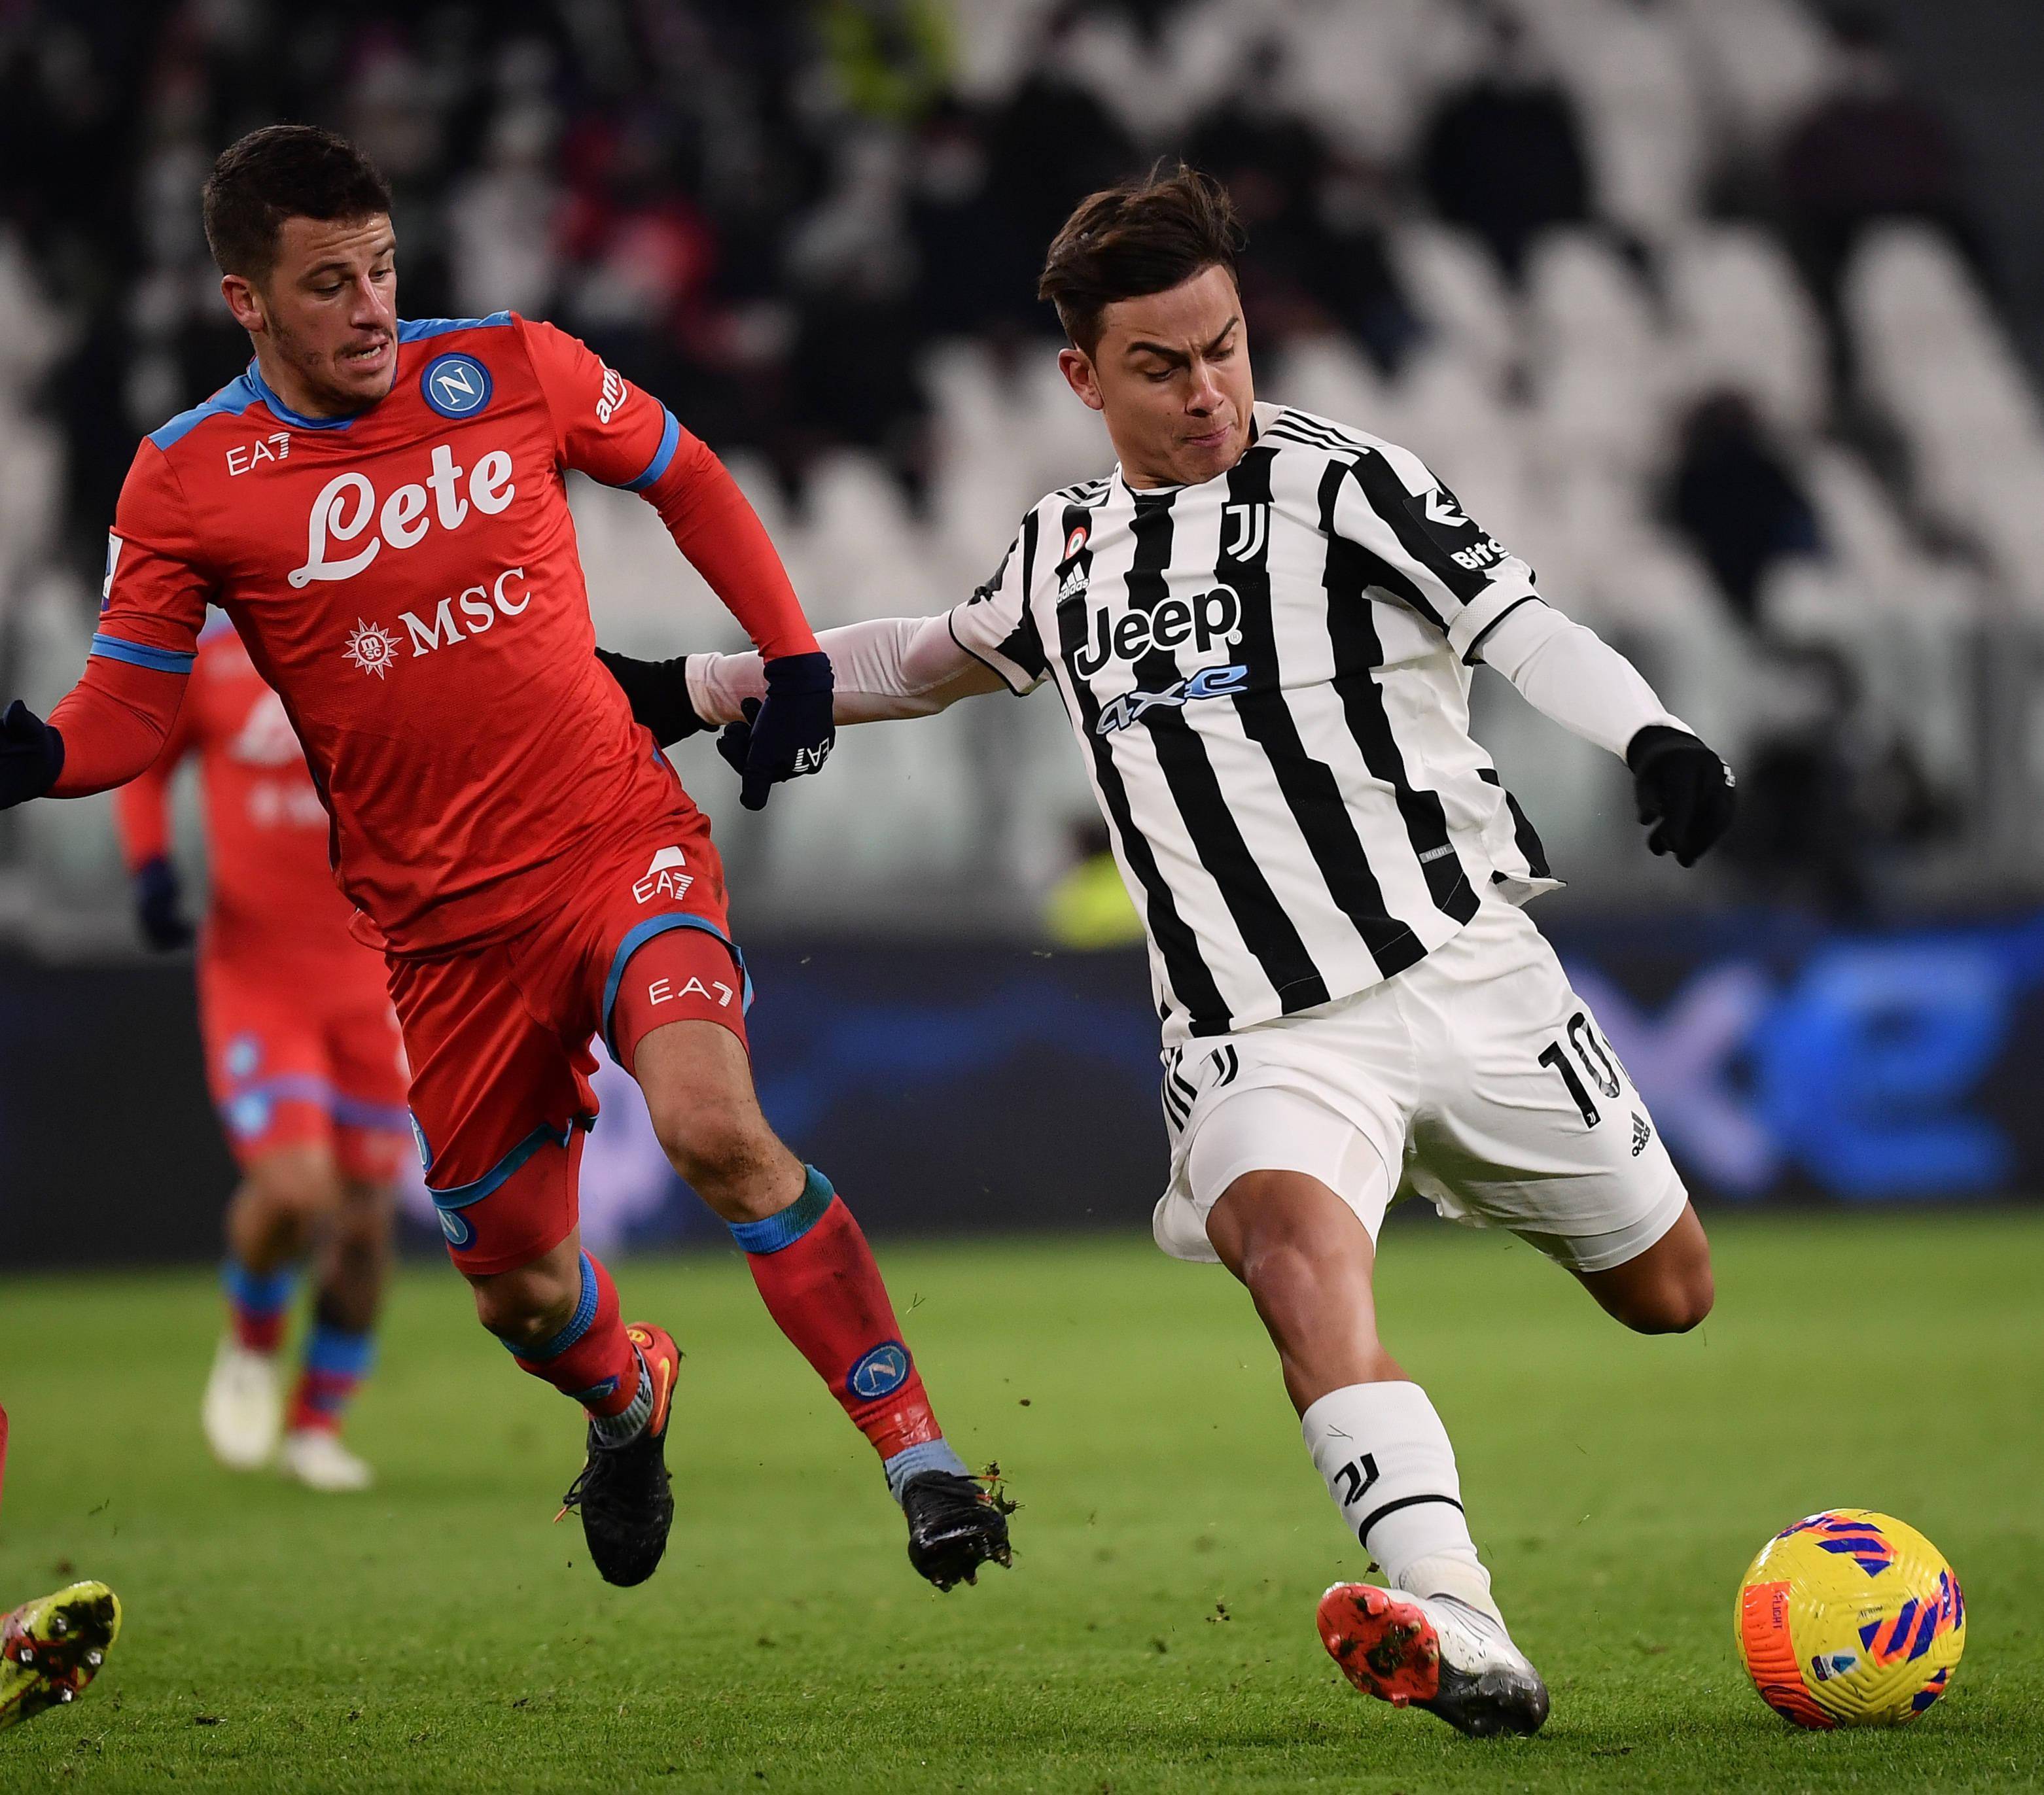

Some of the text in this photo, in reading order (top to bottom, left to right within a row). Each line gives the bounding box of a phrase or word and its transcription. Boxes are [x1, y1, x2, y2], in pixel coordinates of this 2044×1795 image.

[436, 367, 474, 404] N
[226, 432, 291, 476] EA7
[288, 445, 515, 588] Lete
[398, 568, 531, 657] MSC
[1057, 578, 1089, 603] adidas
[1074, 587, 1237, 676] Jeep
[1097, 665, 1248, 735] 4xe
[632, 870, 694, 904] EA7
[648, 977, 733, 1007] EA7
[1538, 1012, 1621, 1129] 10
[865, 1351, 896, 1391] N
